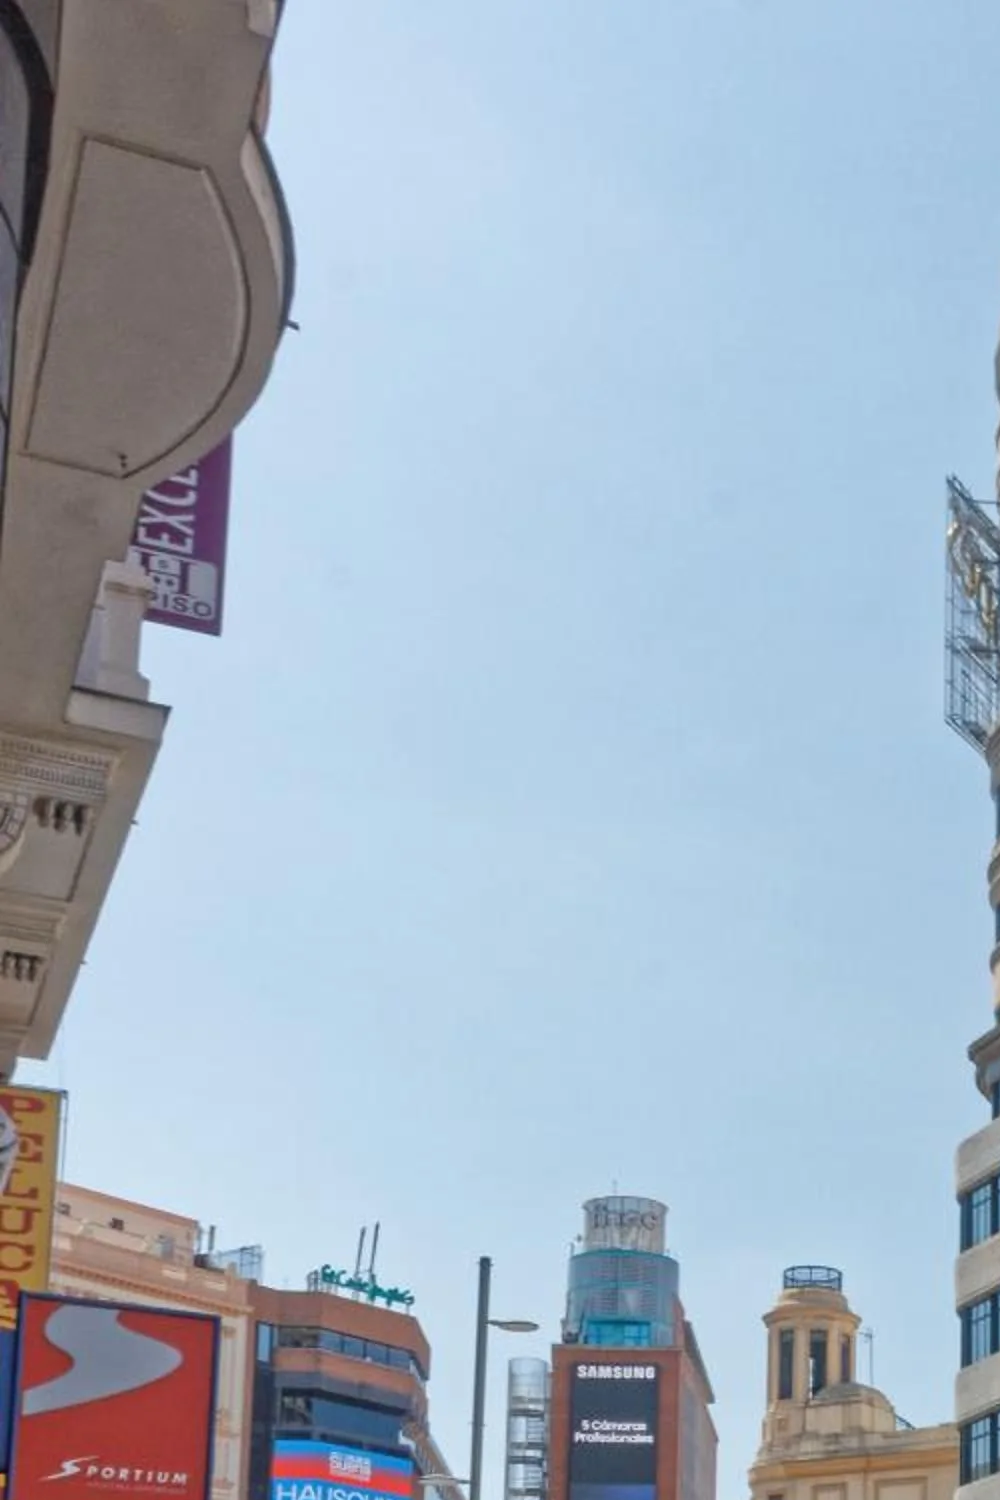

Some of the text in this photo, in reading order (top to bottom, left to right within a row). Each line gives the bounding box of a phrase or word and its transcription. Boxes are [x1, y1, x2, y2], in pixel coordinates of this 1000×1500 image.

[577, 1365, 655, 1379] SAMSUNG
[581, 1419, 590, 1431] 5
[37, 1455, 188, 1485] SPORTIUM
